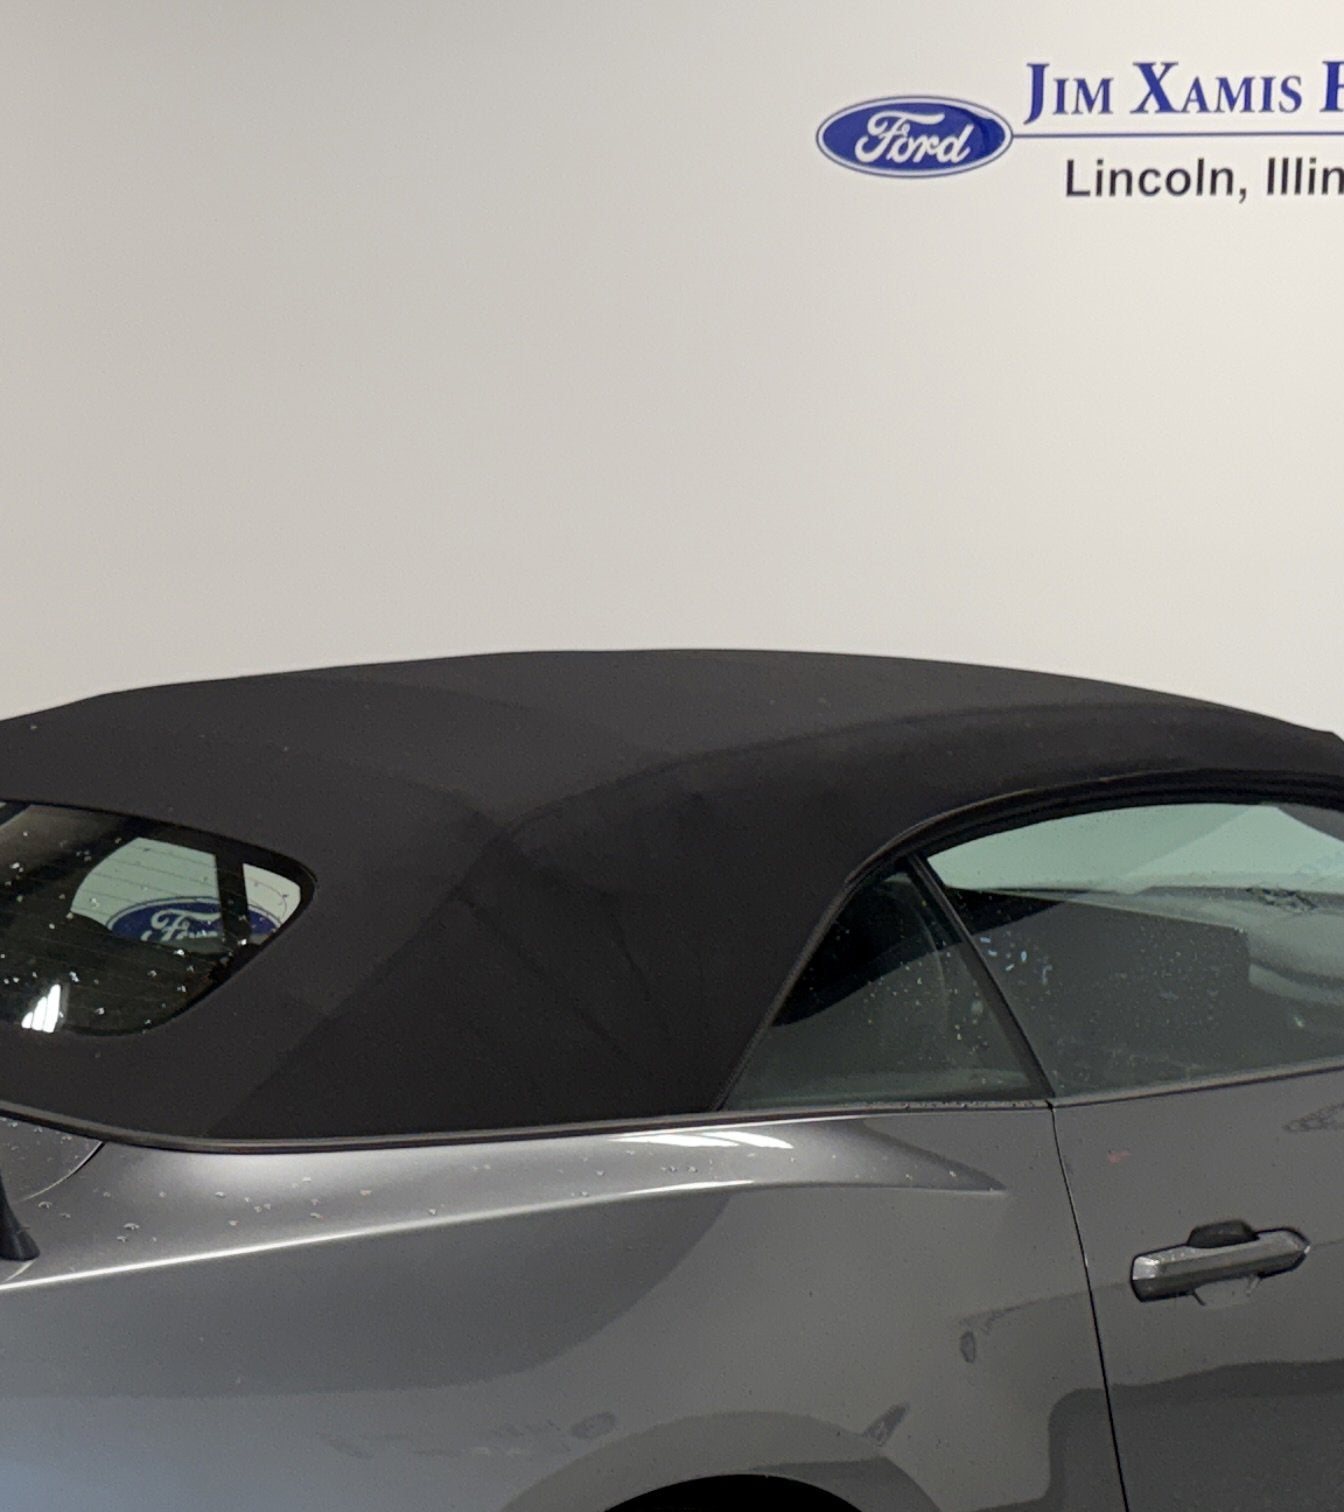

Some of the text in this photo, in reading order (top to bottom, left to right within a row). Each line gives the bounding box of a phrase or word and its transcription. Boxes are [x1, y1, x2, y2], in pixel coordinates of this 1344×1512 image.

[1023, 62, 1113, 125] JIM
[1130, 60, 1303, 114] XAMIS
[855, 110, 974, 165] Ford
[1065, 158, 1248, 203] Lincoln,
